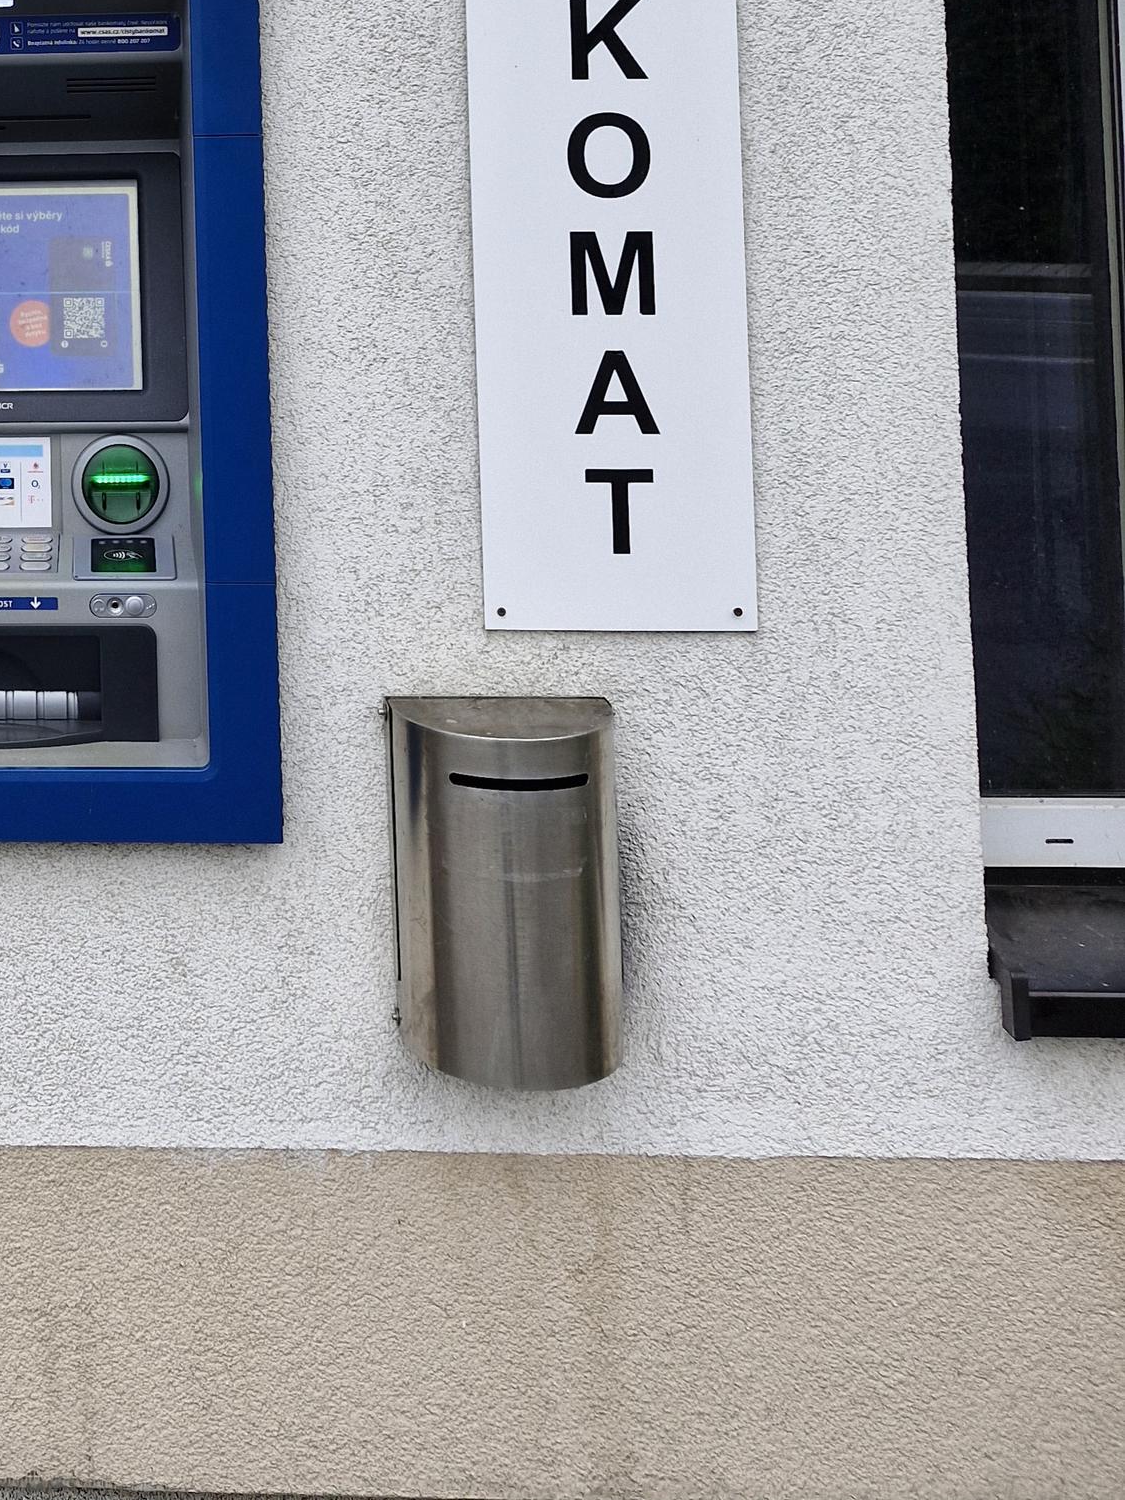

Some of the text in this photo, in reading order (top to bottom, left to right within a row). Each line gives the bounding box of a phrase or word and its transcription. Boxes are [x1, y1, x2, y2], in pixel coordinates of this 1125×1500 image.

[14, 211, 25, 220] si
[26, 210, 63, 222] výběry
[0, 224, 20, 234] kód
